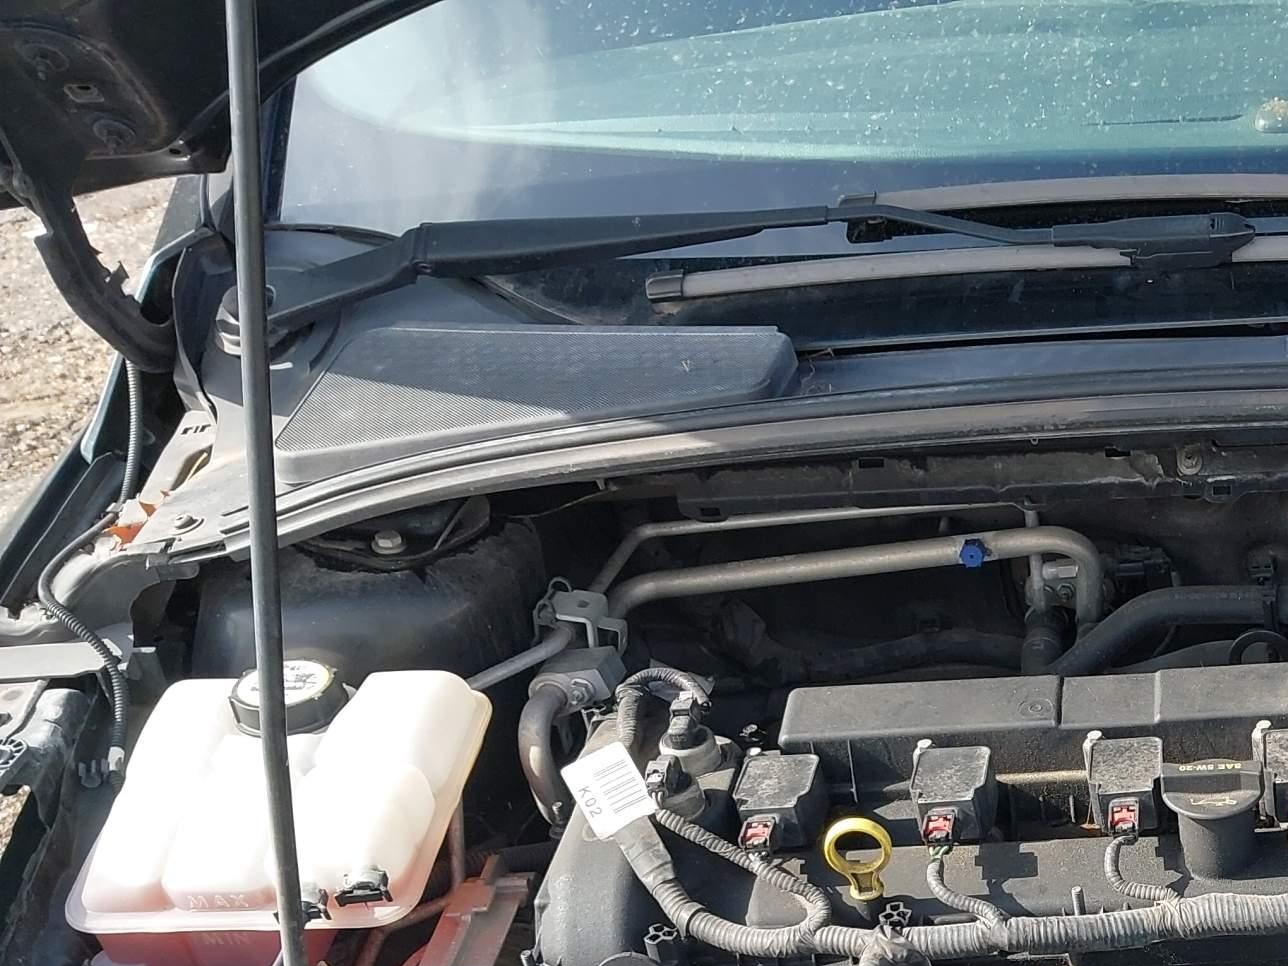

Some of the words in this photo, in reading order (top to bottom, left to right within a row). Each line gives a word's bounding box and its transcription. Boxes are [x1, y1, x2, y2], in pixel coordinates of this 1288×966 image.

[1178, 764, 1214, 772] 5W-20
[1217, 762, 1242, 771] SAE
[578, 785, 602, 819] K02
[188, 894, 249, 909] MAX
[203, 931, 250, 945] MIN
